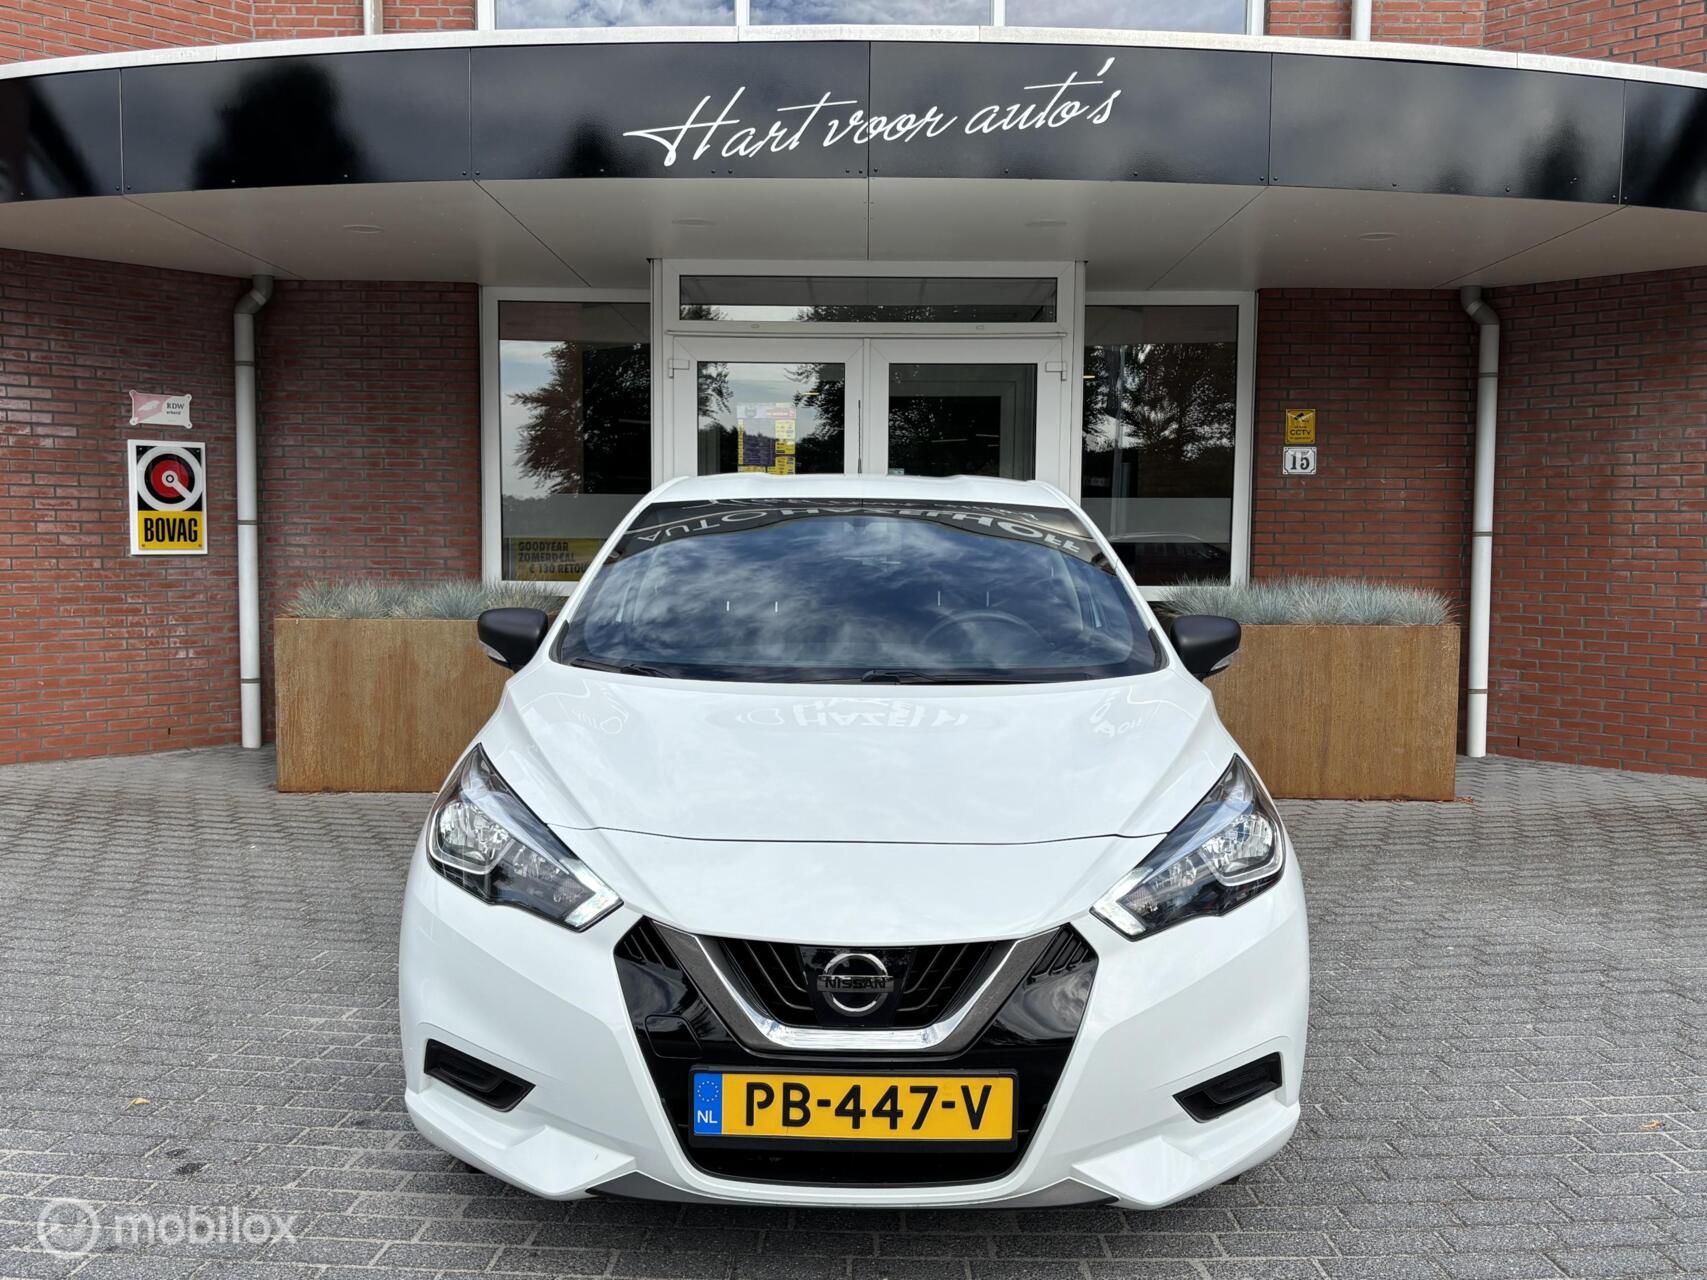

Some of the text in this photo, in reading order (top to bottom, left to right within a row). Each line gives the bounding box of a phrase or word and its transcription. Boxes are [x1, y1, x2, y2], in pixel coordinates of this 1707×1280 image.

[622, 57, 1122, 167] Hart voor auto's
[166, 402, 185, 410] RDW
[1290, 452, 1310, 471] 15
[143, 517, 198, 543] BOVAG
[518, 541, 569, 551] GOODYEAR
[518, 552, 576, 562] ZOMERDEAL
[825, 977, 887, 989] NISSAN
[697, 1081, 993, 1131] NL PB-447-V
